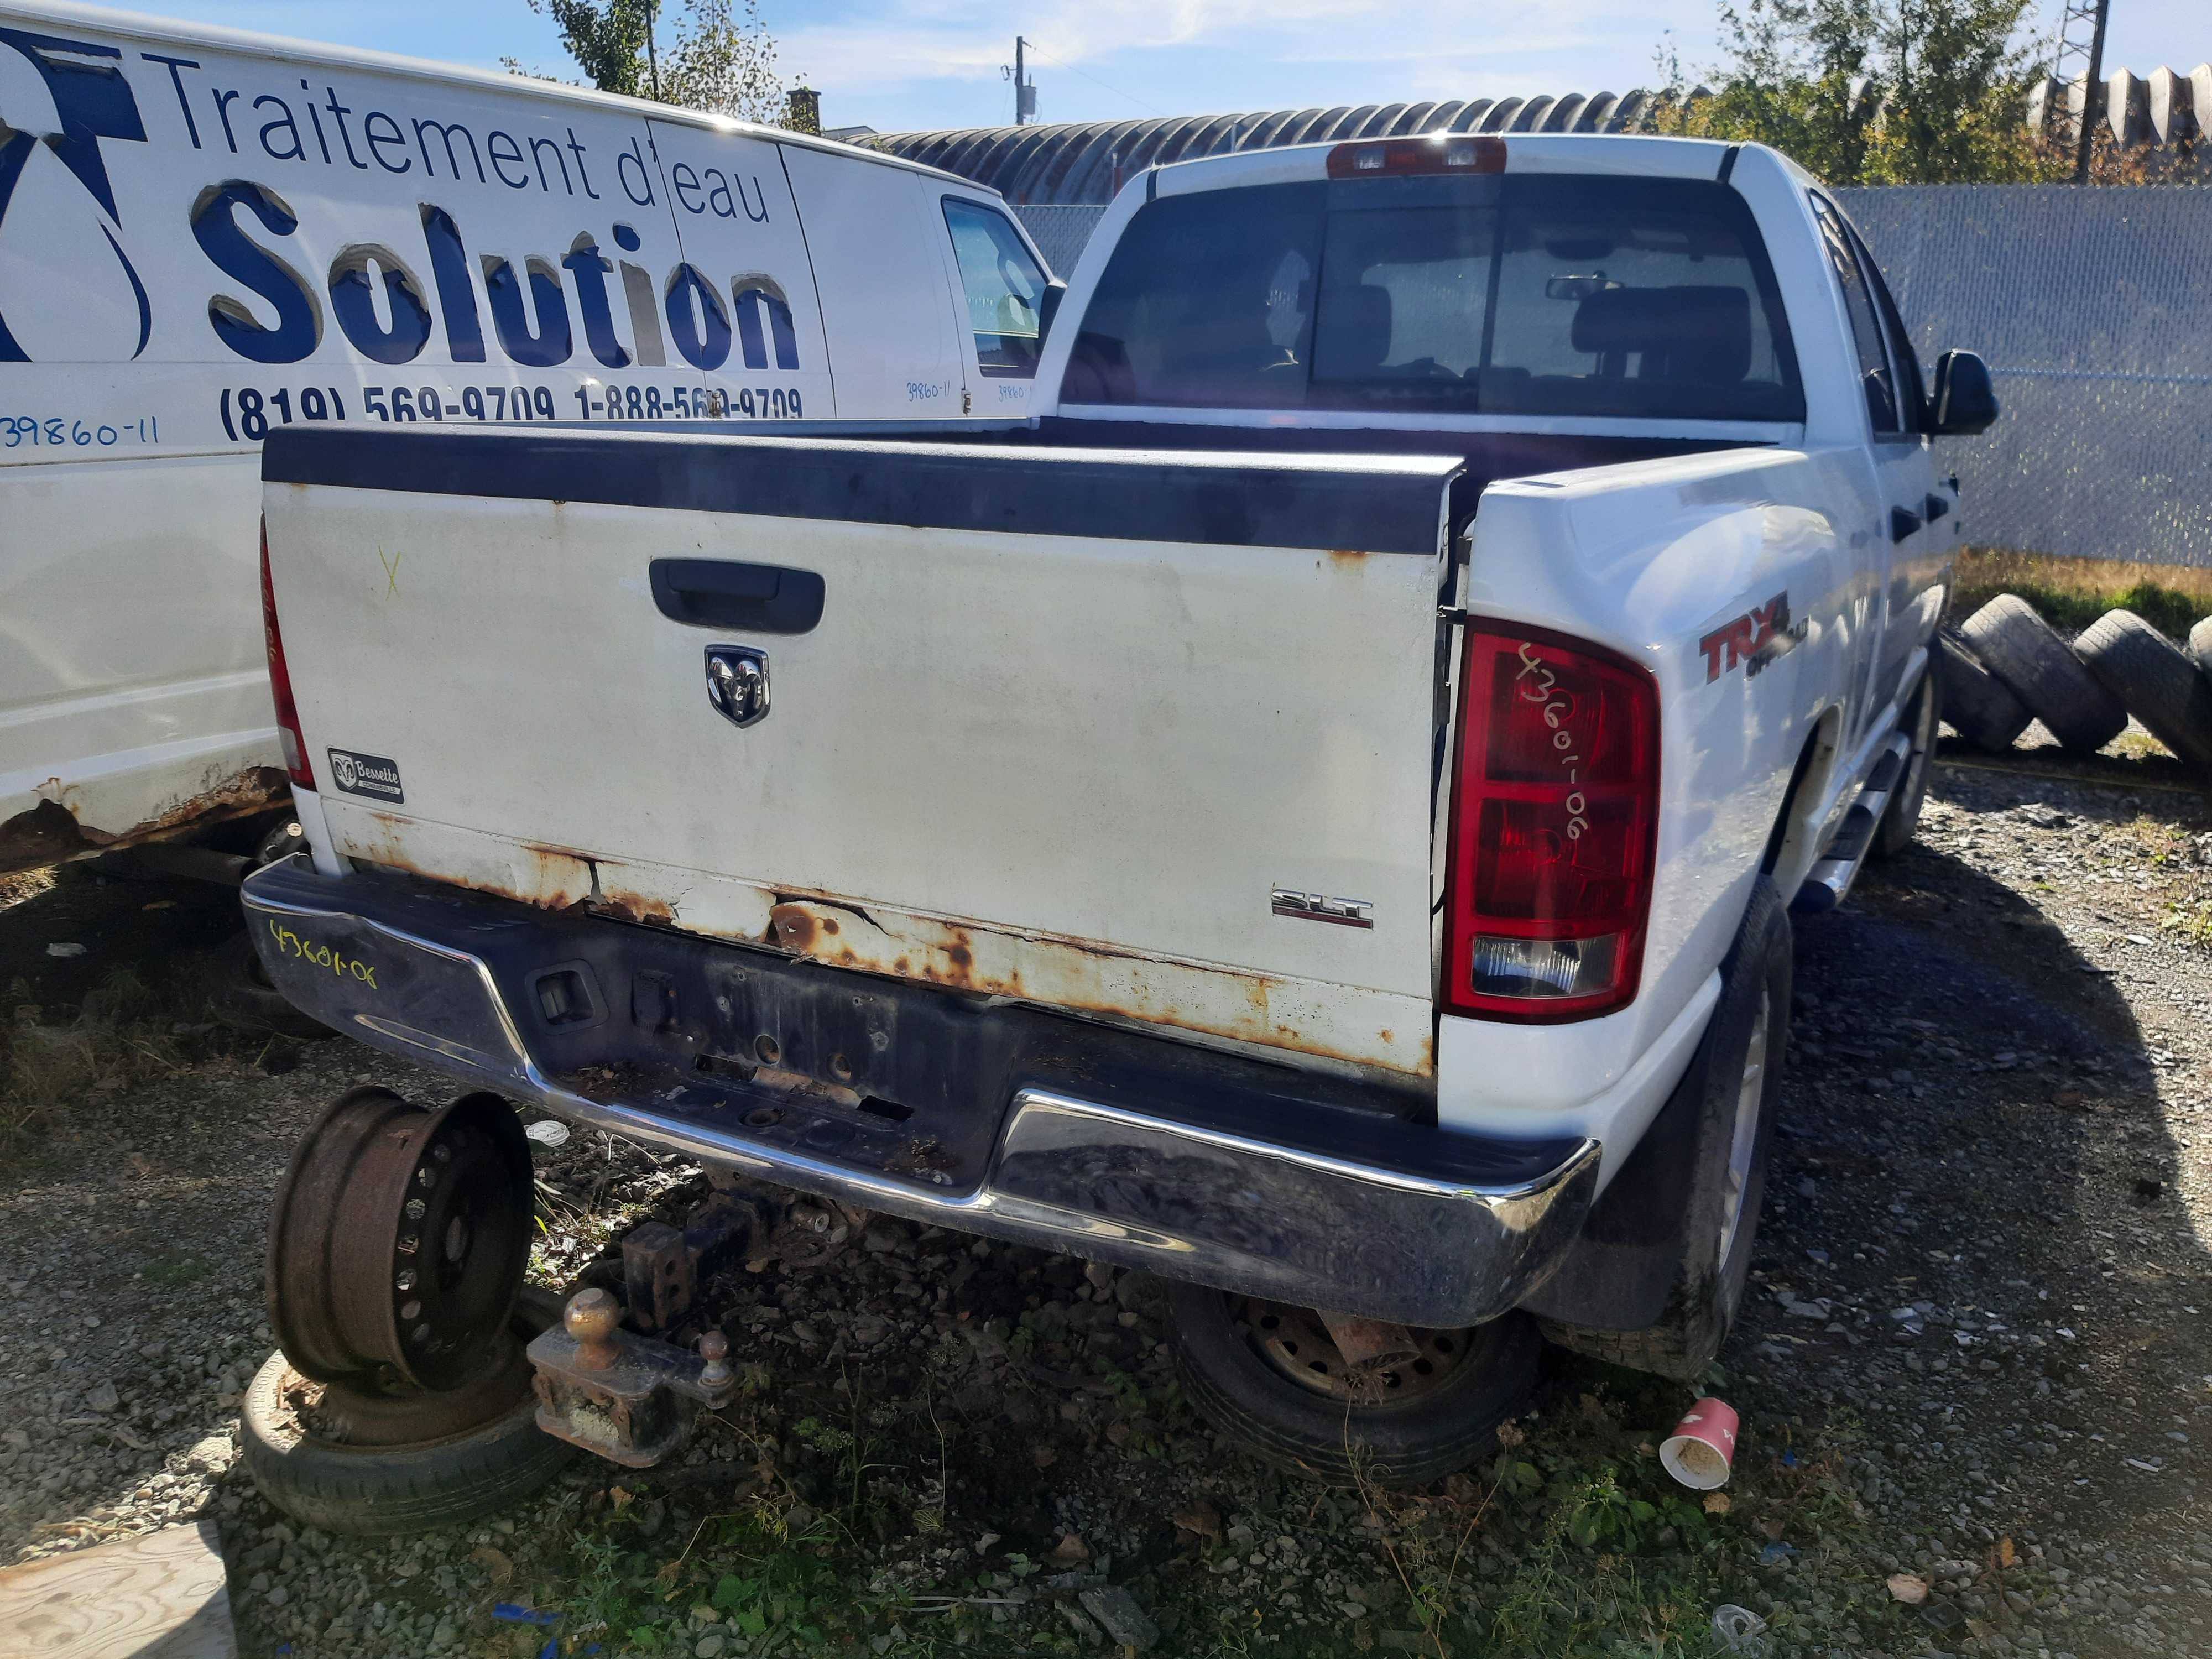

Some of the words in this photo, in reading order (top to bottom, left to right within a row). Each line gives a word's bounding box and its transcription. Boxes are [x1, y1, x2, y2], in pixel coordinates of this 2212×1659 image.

[142, 53, 601, 200] Traitement
[617, 136, 770, 223] d'eau
[190, 178, 800, 371] Solution
[906, 380, 950, 402] 39860-11
[0, 416, 159, 447] 39860-11
[1515, 641, 1589, 841] 43601-06
[354, 760, 399, 784] Bessette
[1272, 889, 1373, 919] SLT
[269, 919, 378, 990] 43601-06
